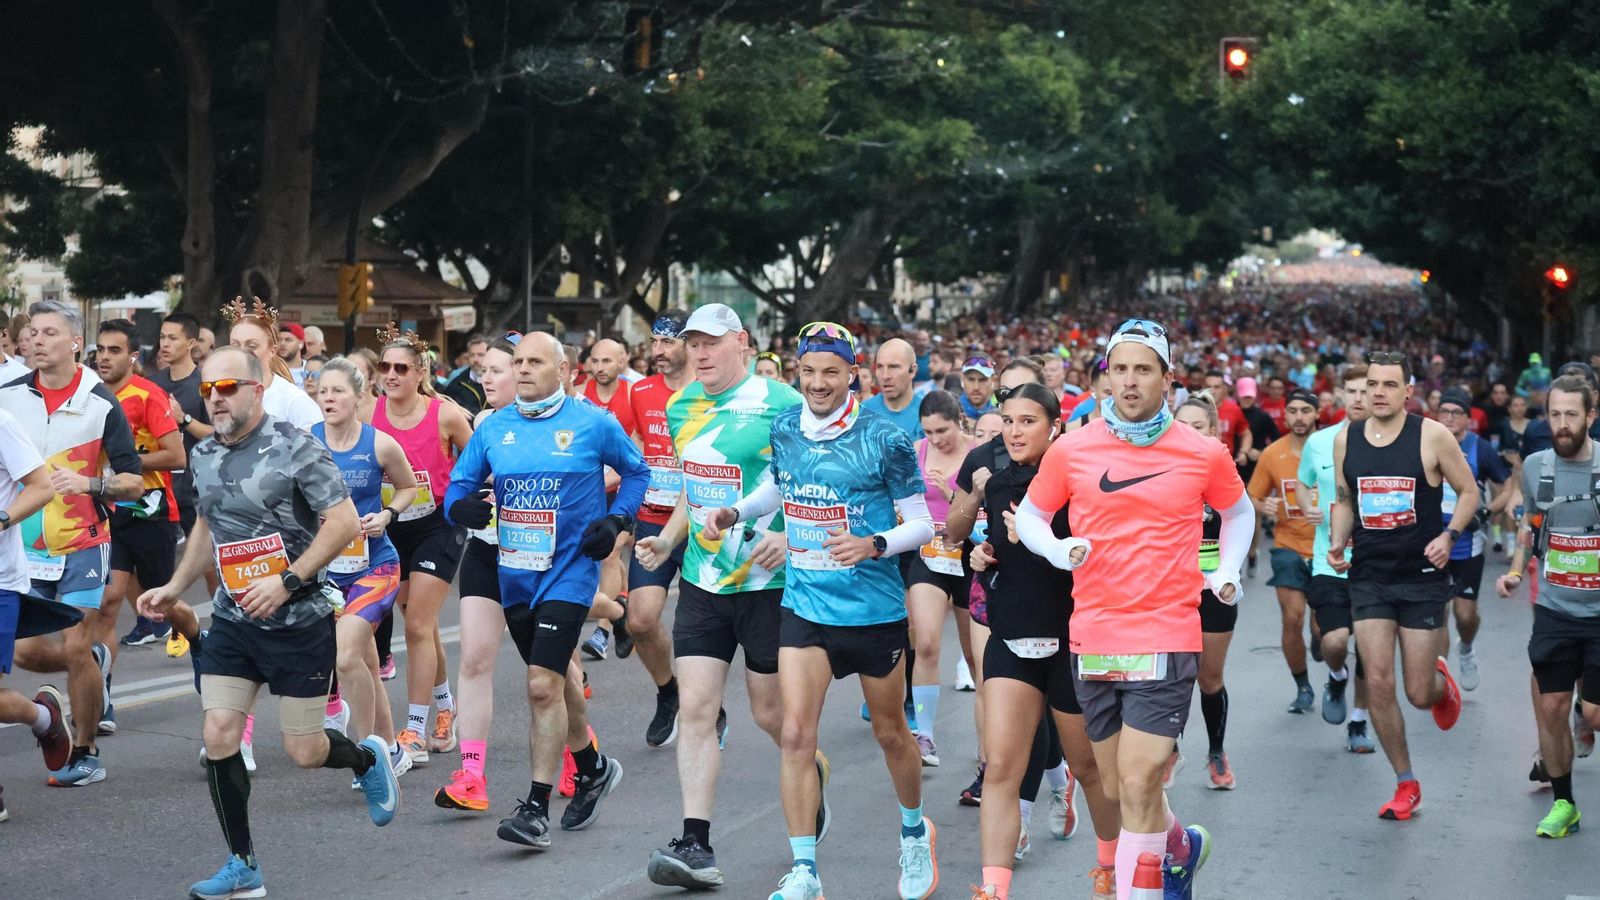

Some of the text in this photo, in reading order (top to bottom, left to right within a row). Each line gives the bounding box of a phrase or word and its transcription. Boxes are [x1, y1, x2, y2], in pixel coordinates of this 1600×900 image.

[694, 464, 736, 478] GENERALI
[504, 478, 562, 492] ORO DE
[652, 473, 681, 485] 12475
[1373, 480, 1411, 489] GENERALI
[693, 484, 727, 500] 16266
[794, 483, 839, 501] MEDIA
[507, 512, 550, 523] GENERALI
[797, 508, 841, 520] GENERALI
[506, 530, 541, 544] 12766
[1558, 538, 1598, 548] GENERALI
[231, 538, 277, 557] GENERALI
[1558, 554, 1586, 567] 6609
[235, 562, 270, 579] 7420
[408, 714, 425, 724] SRC
[461, 752, 480, 761] SRC
